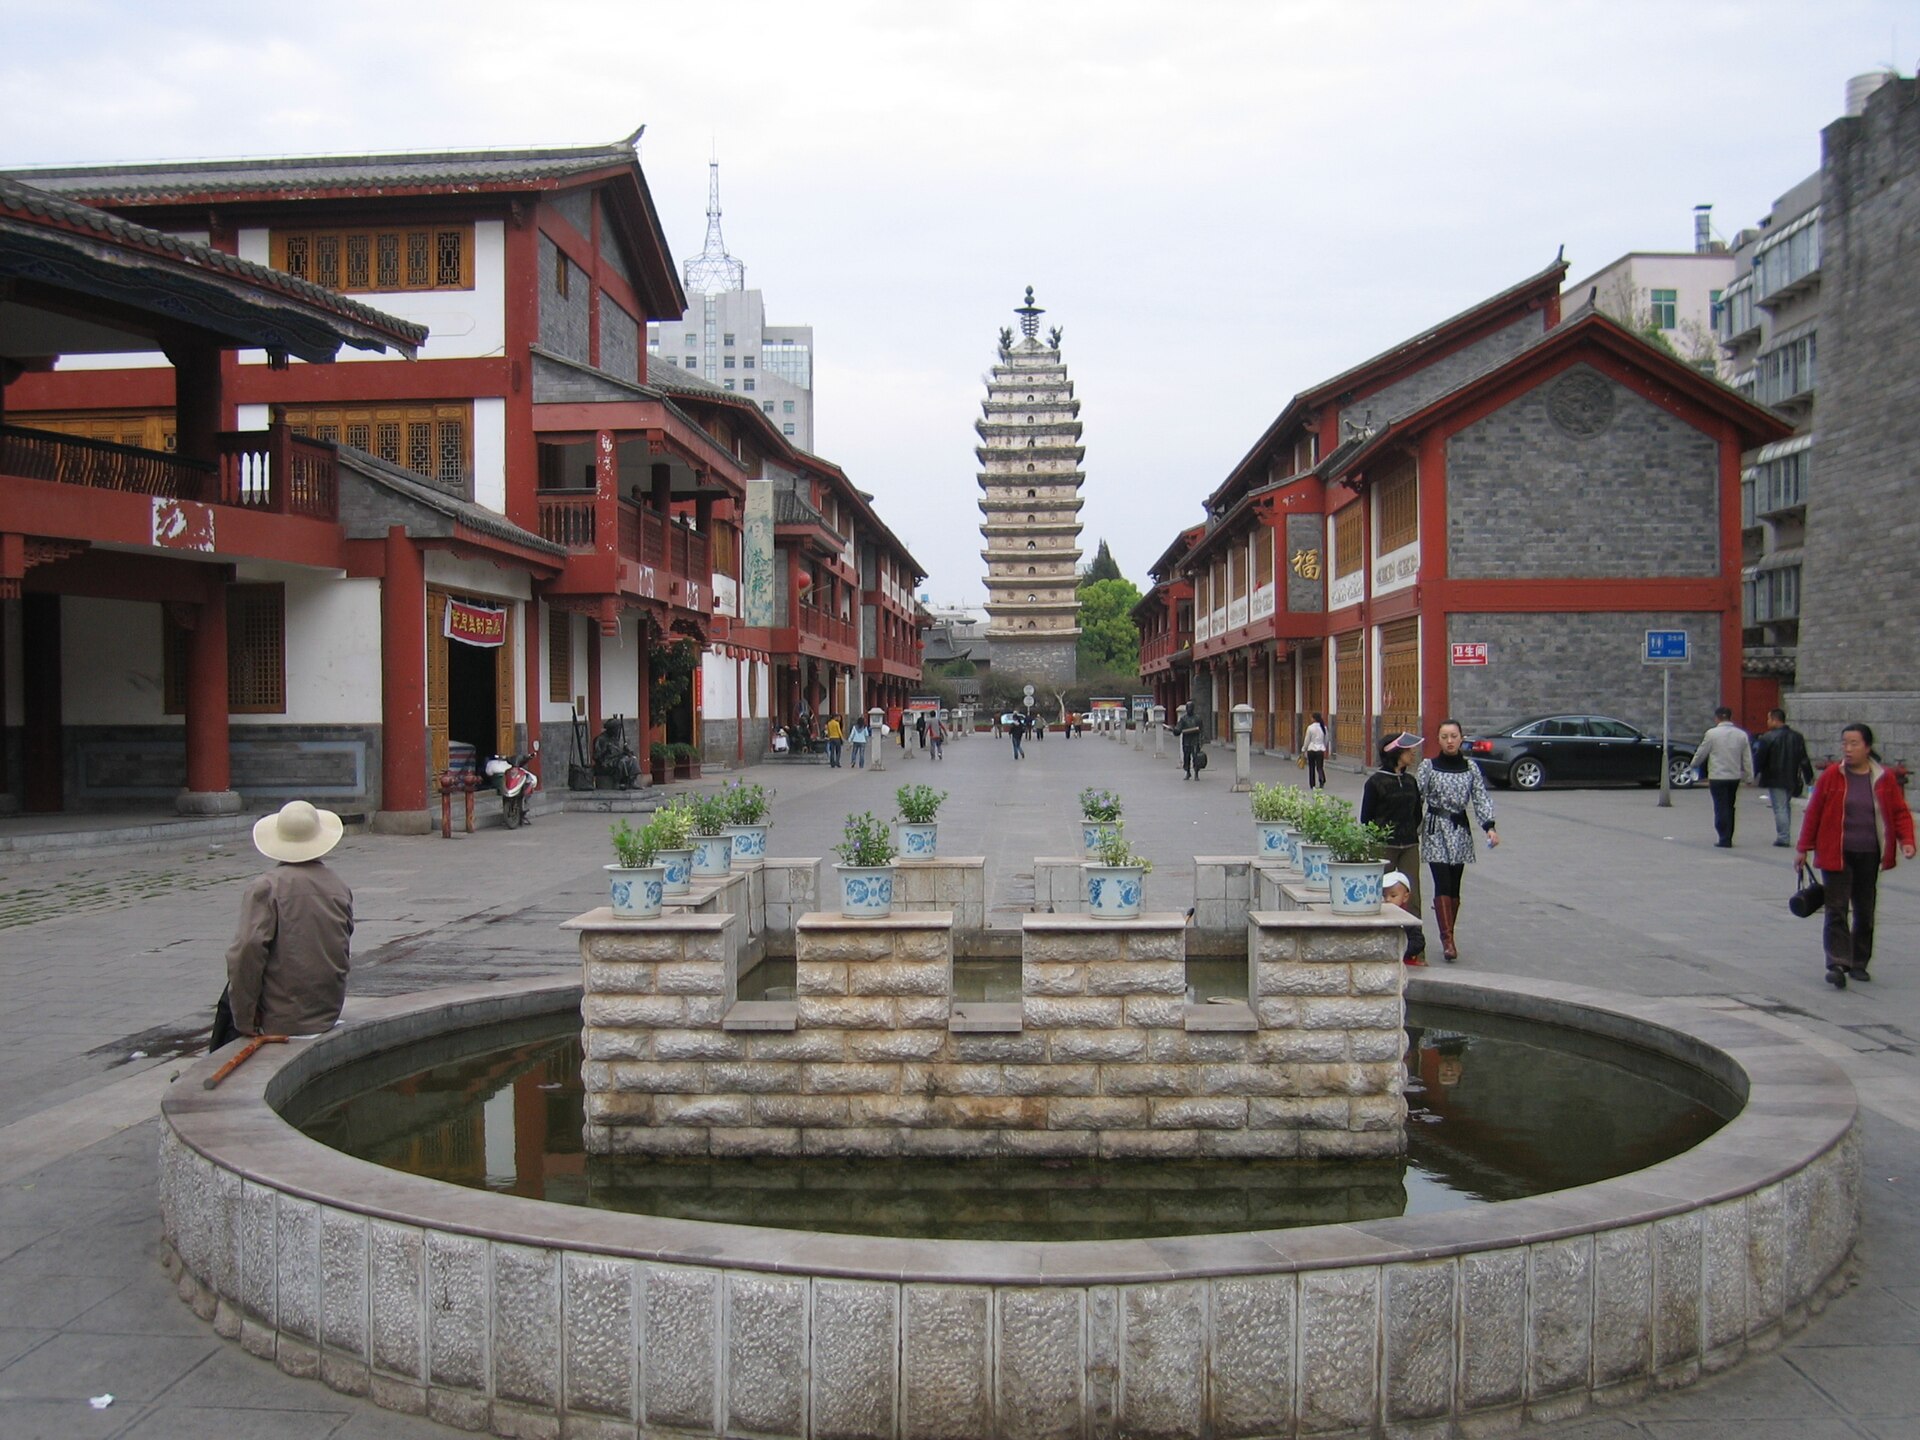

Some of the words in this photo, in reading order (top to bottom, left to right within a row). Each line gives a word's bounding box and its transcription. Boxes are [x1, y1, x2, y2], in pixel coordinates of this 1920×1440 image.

[1290, 549, 1320, 580] 福
[1453, 645, 1485, 657] 卫生间
